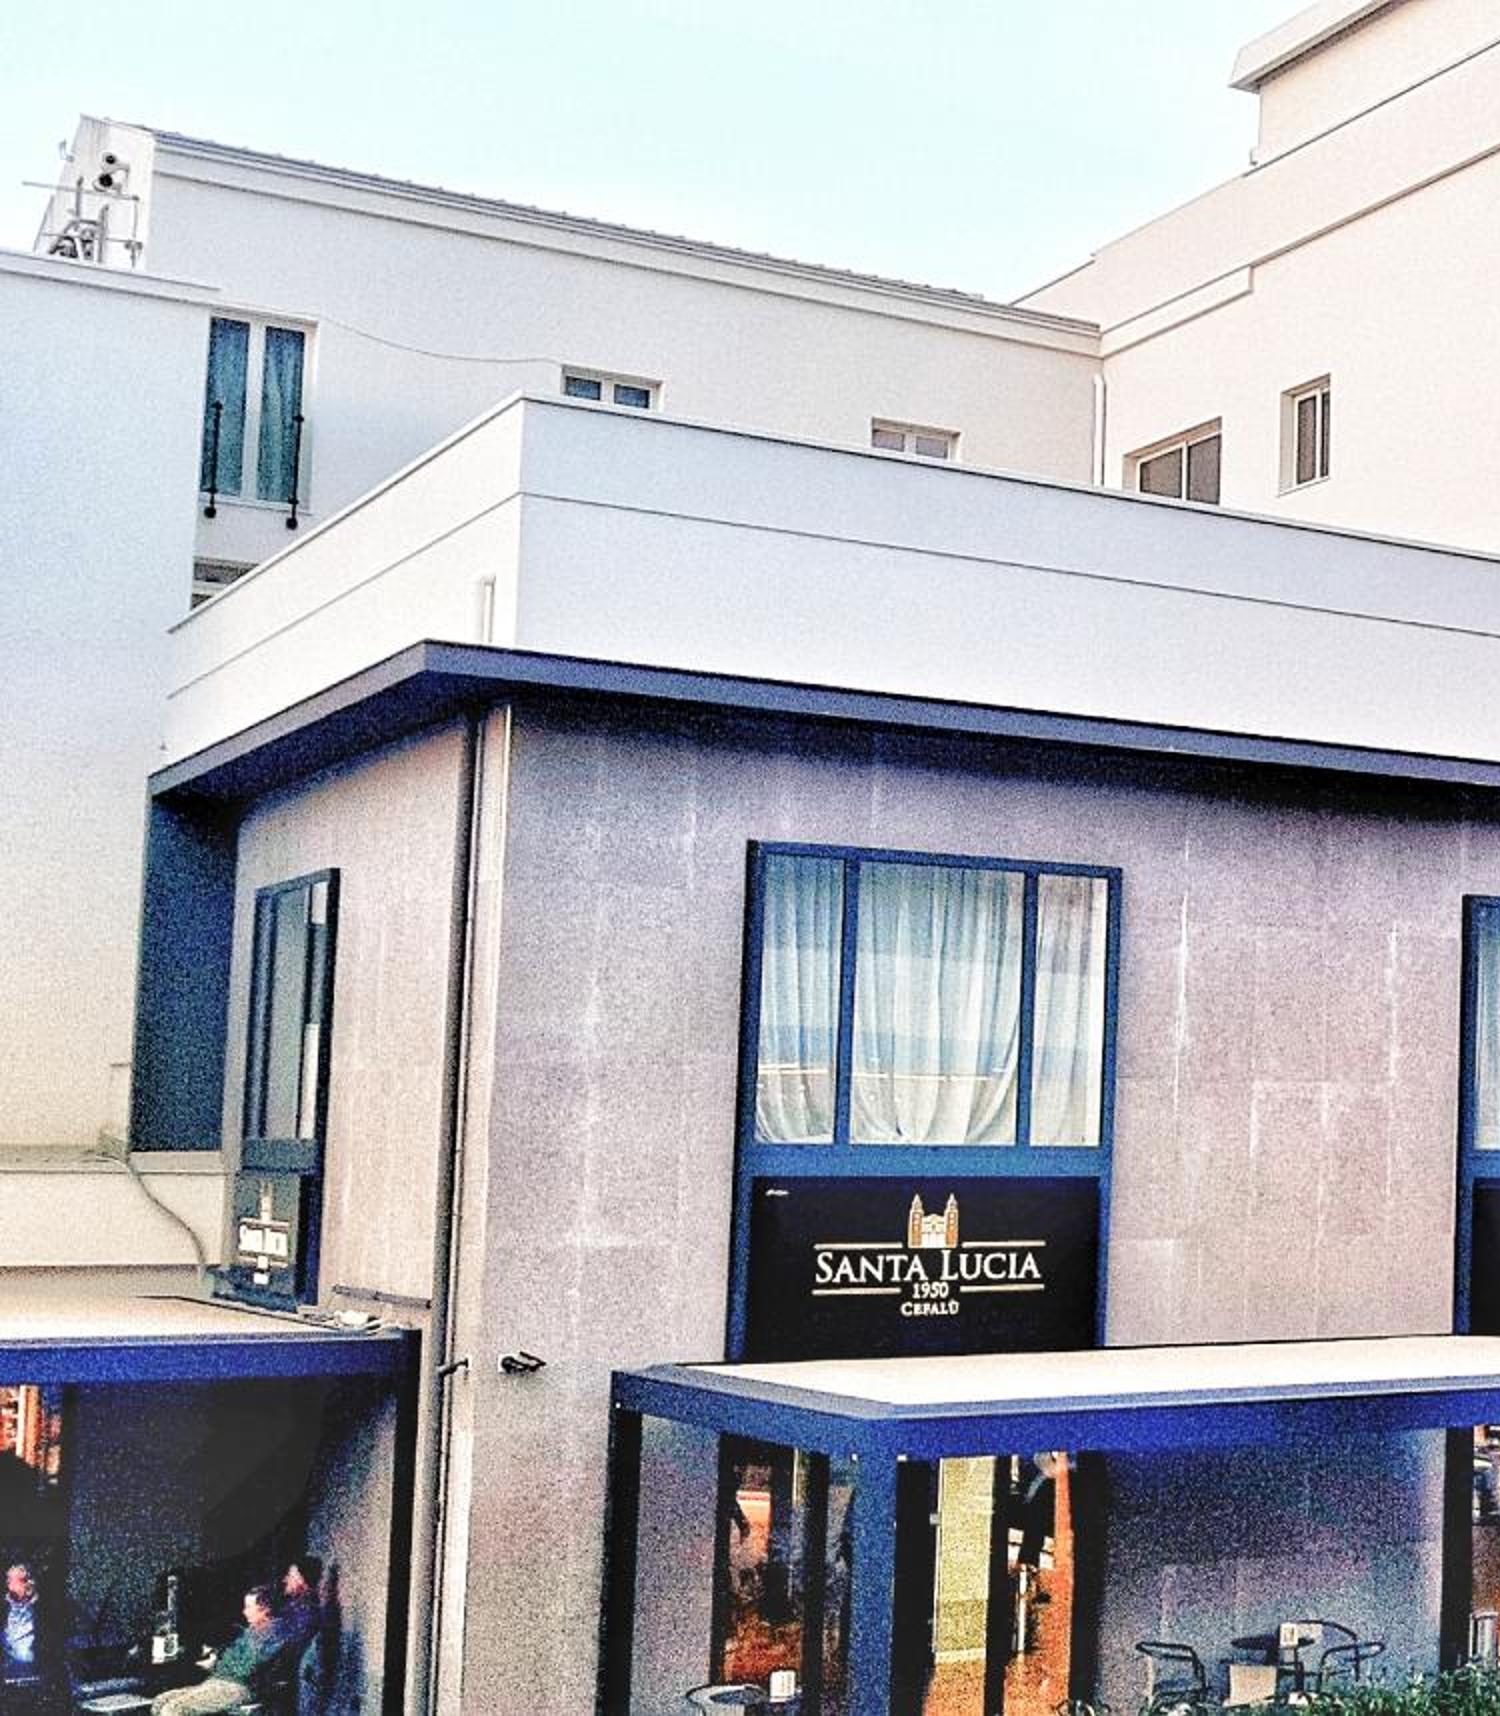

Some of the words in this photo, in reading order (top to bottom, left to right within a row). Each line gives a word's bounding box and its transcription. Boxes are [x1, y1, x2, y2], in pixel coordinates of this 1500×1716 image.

[815, 1251, 929, 1284] SANTA
[941, 1249, 1041, 1281] LUCIA
[912, 1282, 949, 1299] 1950
